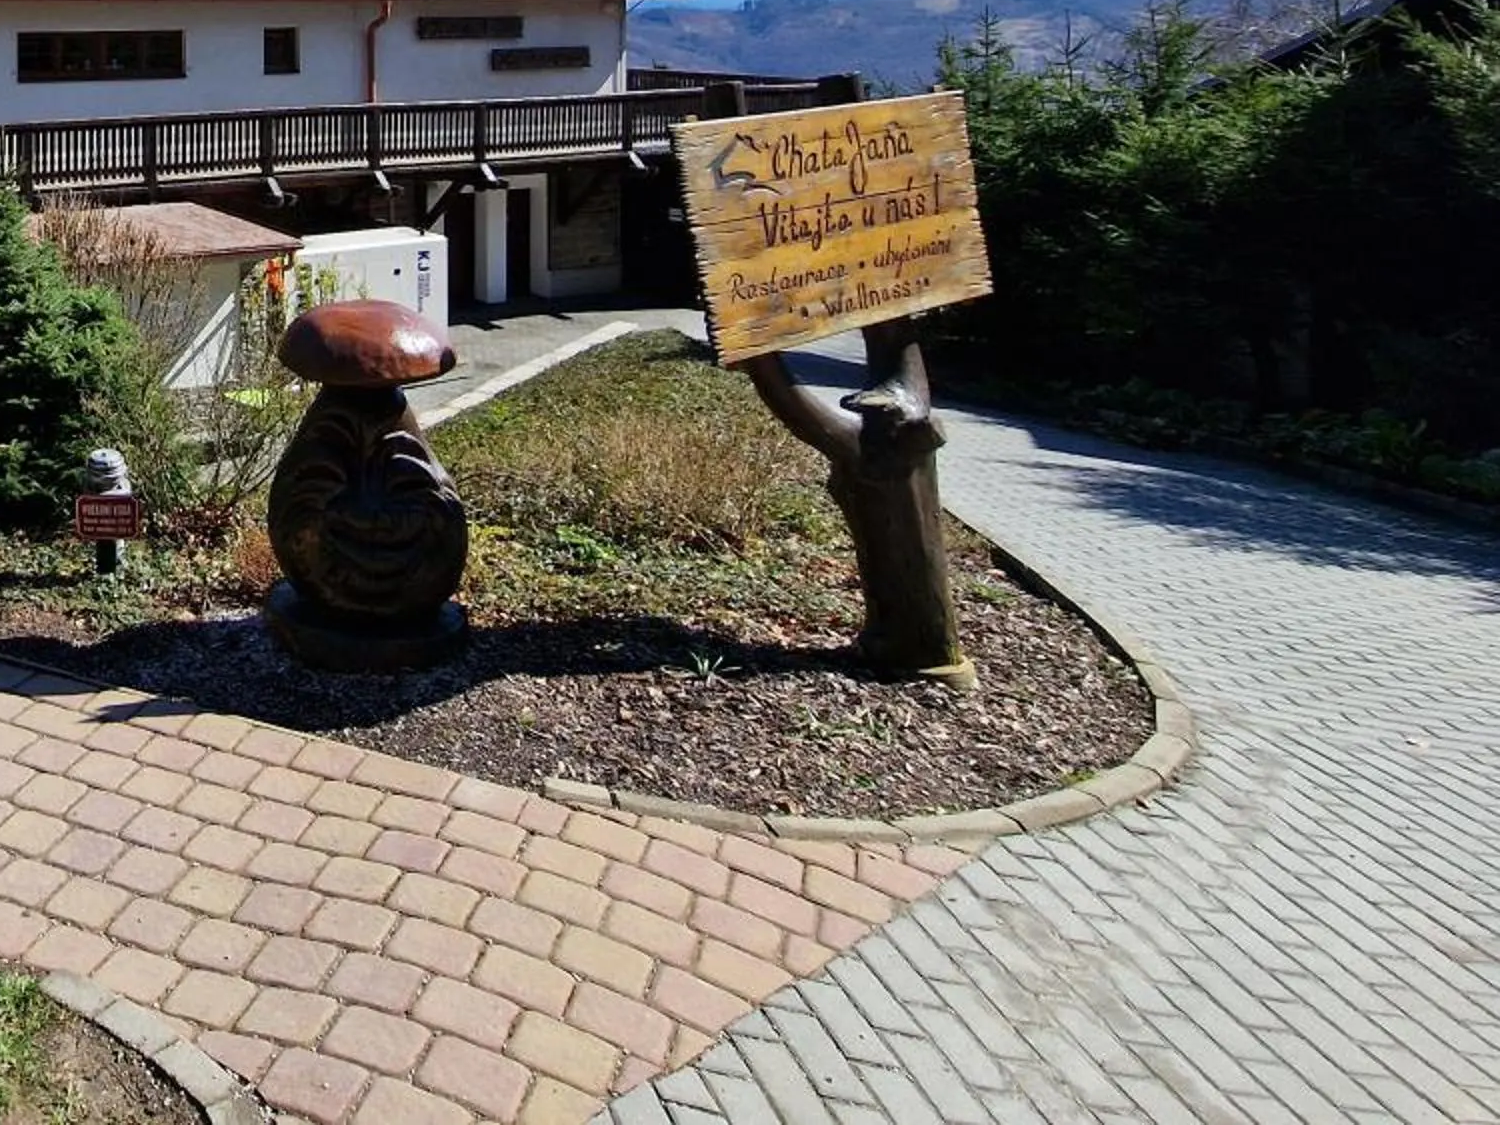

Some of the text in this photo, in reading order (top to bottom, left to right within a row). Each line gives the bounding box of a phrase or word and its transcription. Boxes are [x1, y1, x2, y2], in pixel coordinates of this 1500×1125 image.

[772, 129, 847, 179] Chata
[862, 204, 875, 227] u
[418, 250, 431, 272] KJ
